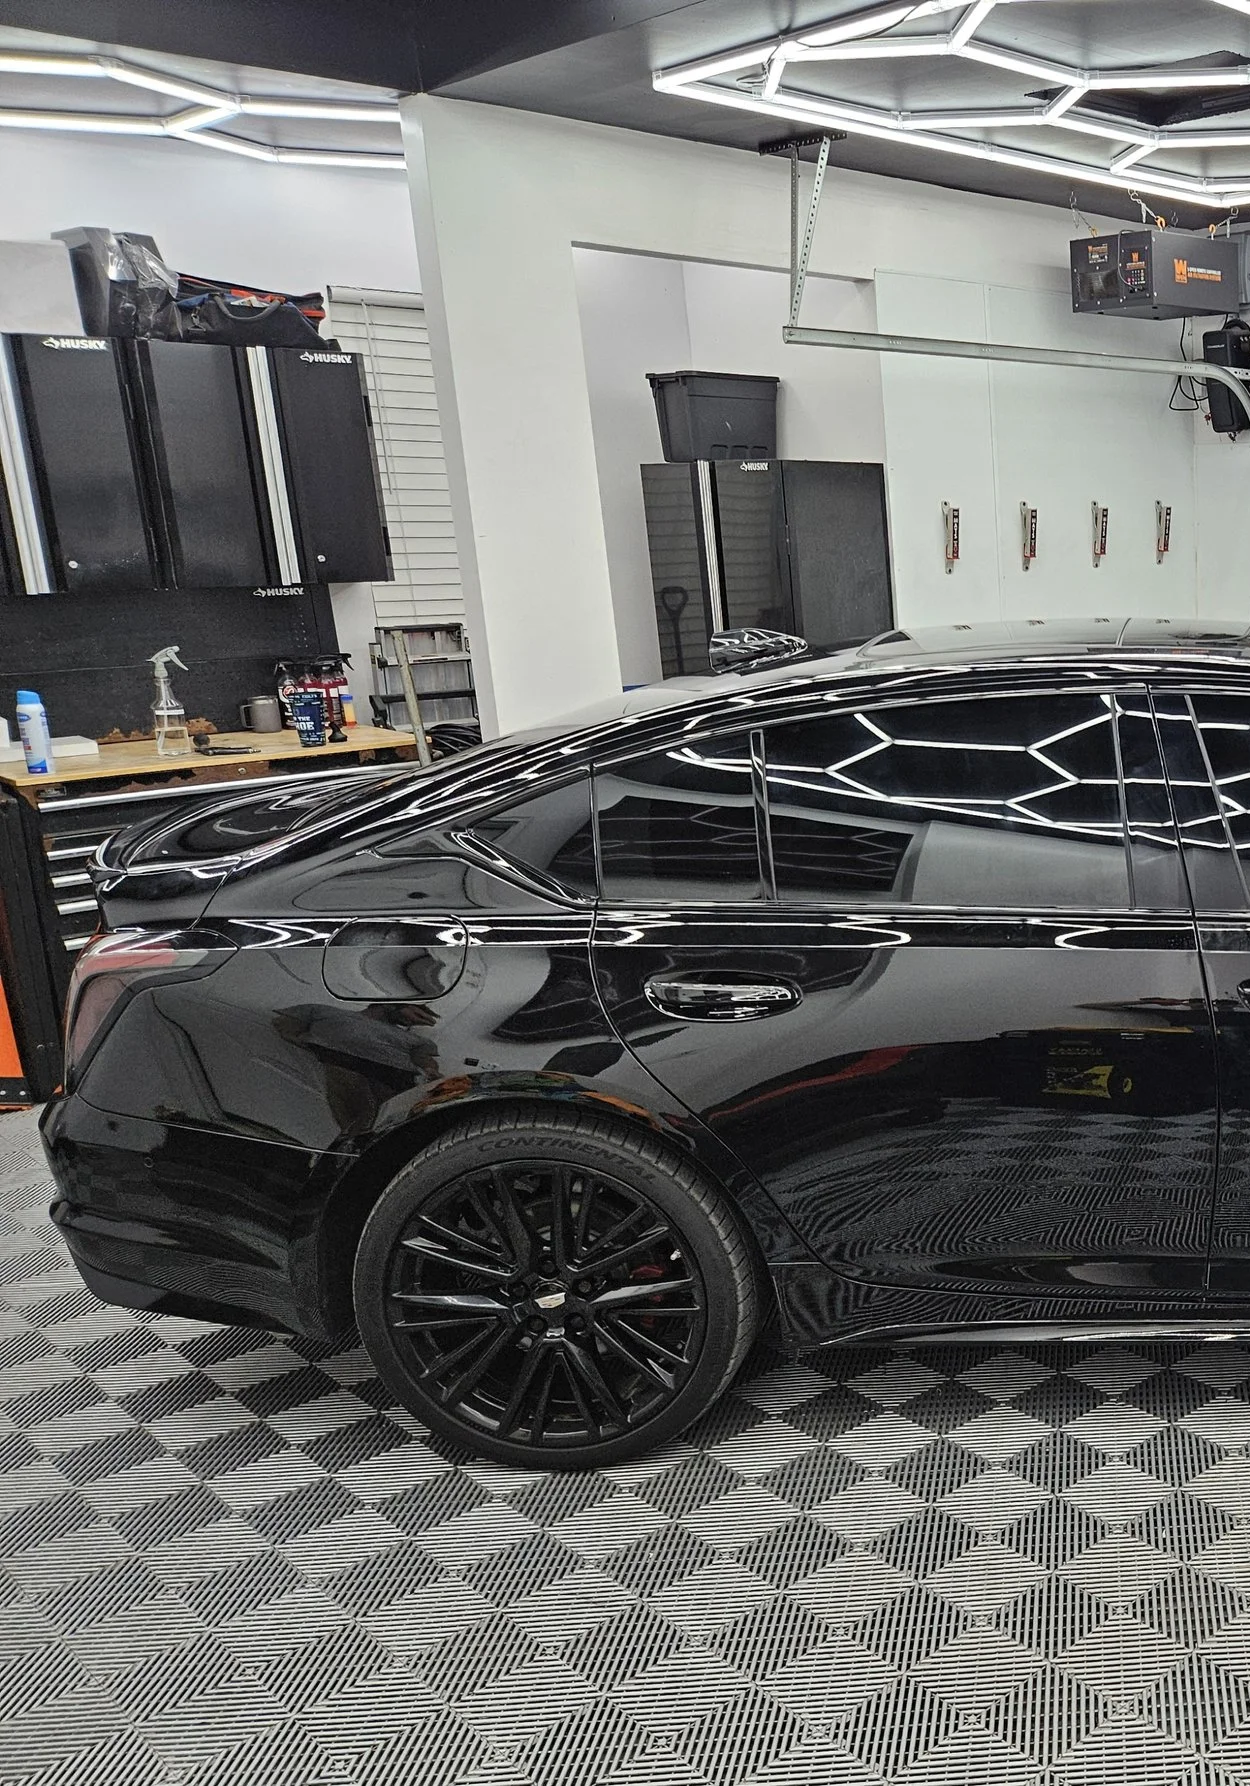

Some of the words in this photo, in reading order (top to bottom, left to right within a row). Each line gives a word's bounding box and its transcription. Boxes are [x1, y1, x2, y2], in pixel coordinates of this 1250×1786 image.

[60, 338, 107, 350] HUSKY
[314, 353, 352, 364] HUSKY
[747, 462, 768, 471] HUSKY
[266, 587, 304, 597] HUSKY
